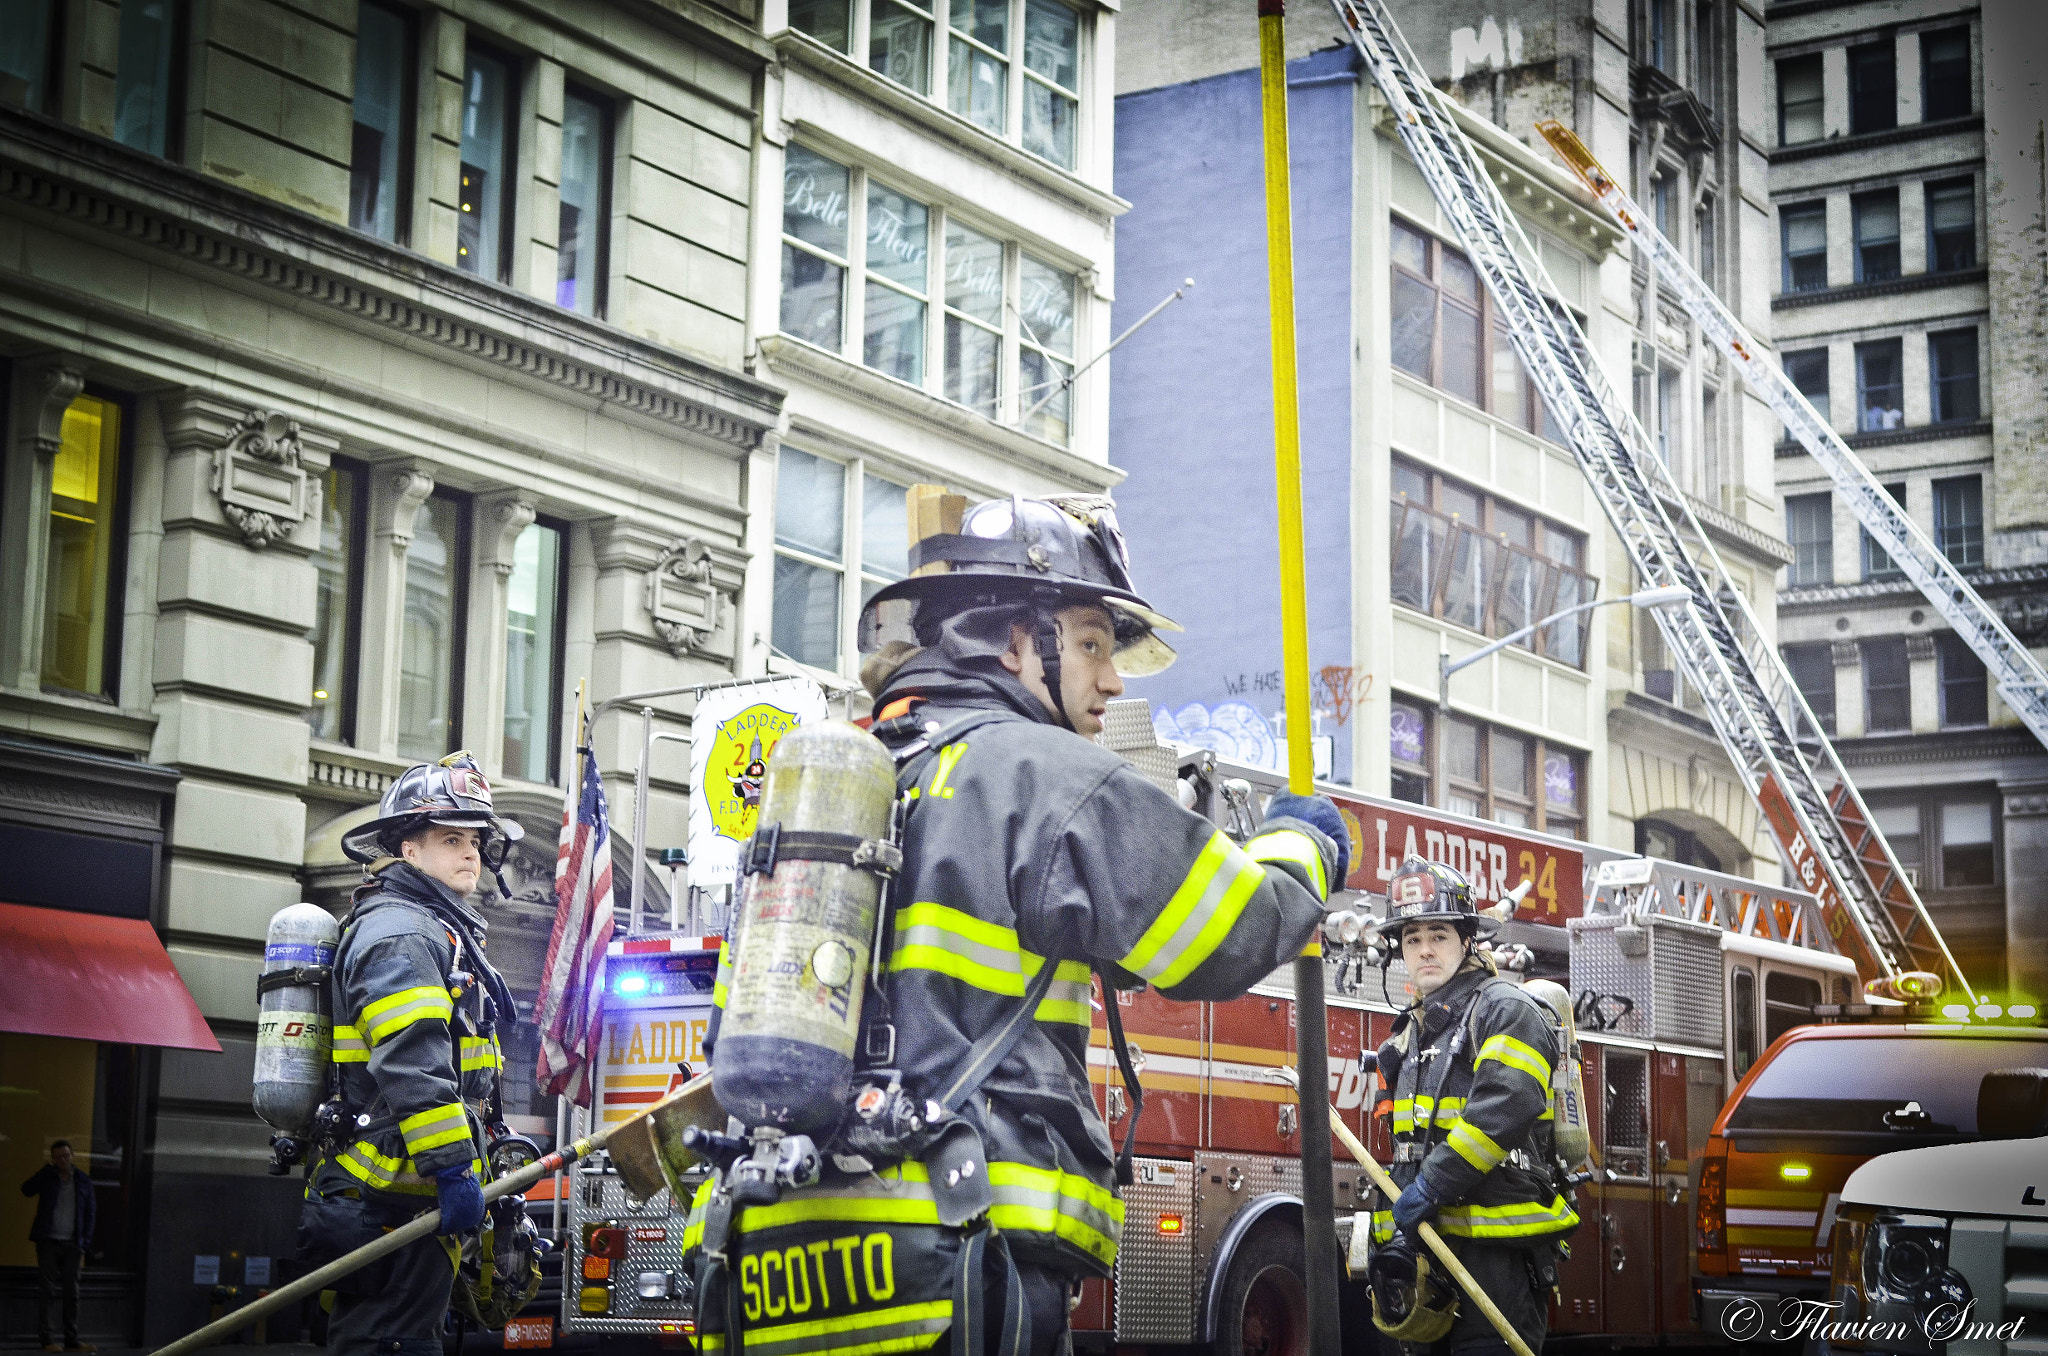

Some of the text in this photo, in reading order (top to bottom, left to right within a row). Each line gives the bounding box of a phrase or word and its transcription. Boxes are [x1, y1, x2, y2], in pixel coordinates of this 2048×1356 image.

[783, 170, 928, 264] Belle Fleur
[949, 249, 1074, 331] Belle Fleur
[726, 713, 788, 741] LADDER
[1376, 818, 1558, 914] LADDER 24
[1401, 876, 1422, 901] 6
[277, 946, 302, 954] SCOTT
[607, 1019, 708, 1066] LADDE
[1564, 1089, 1580, 1127] SCOTT
[740, 1231, 895, 1321] SCOTTO
